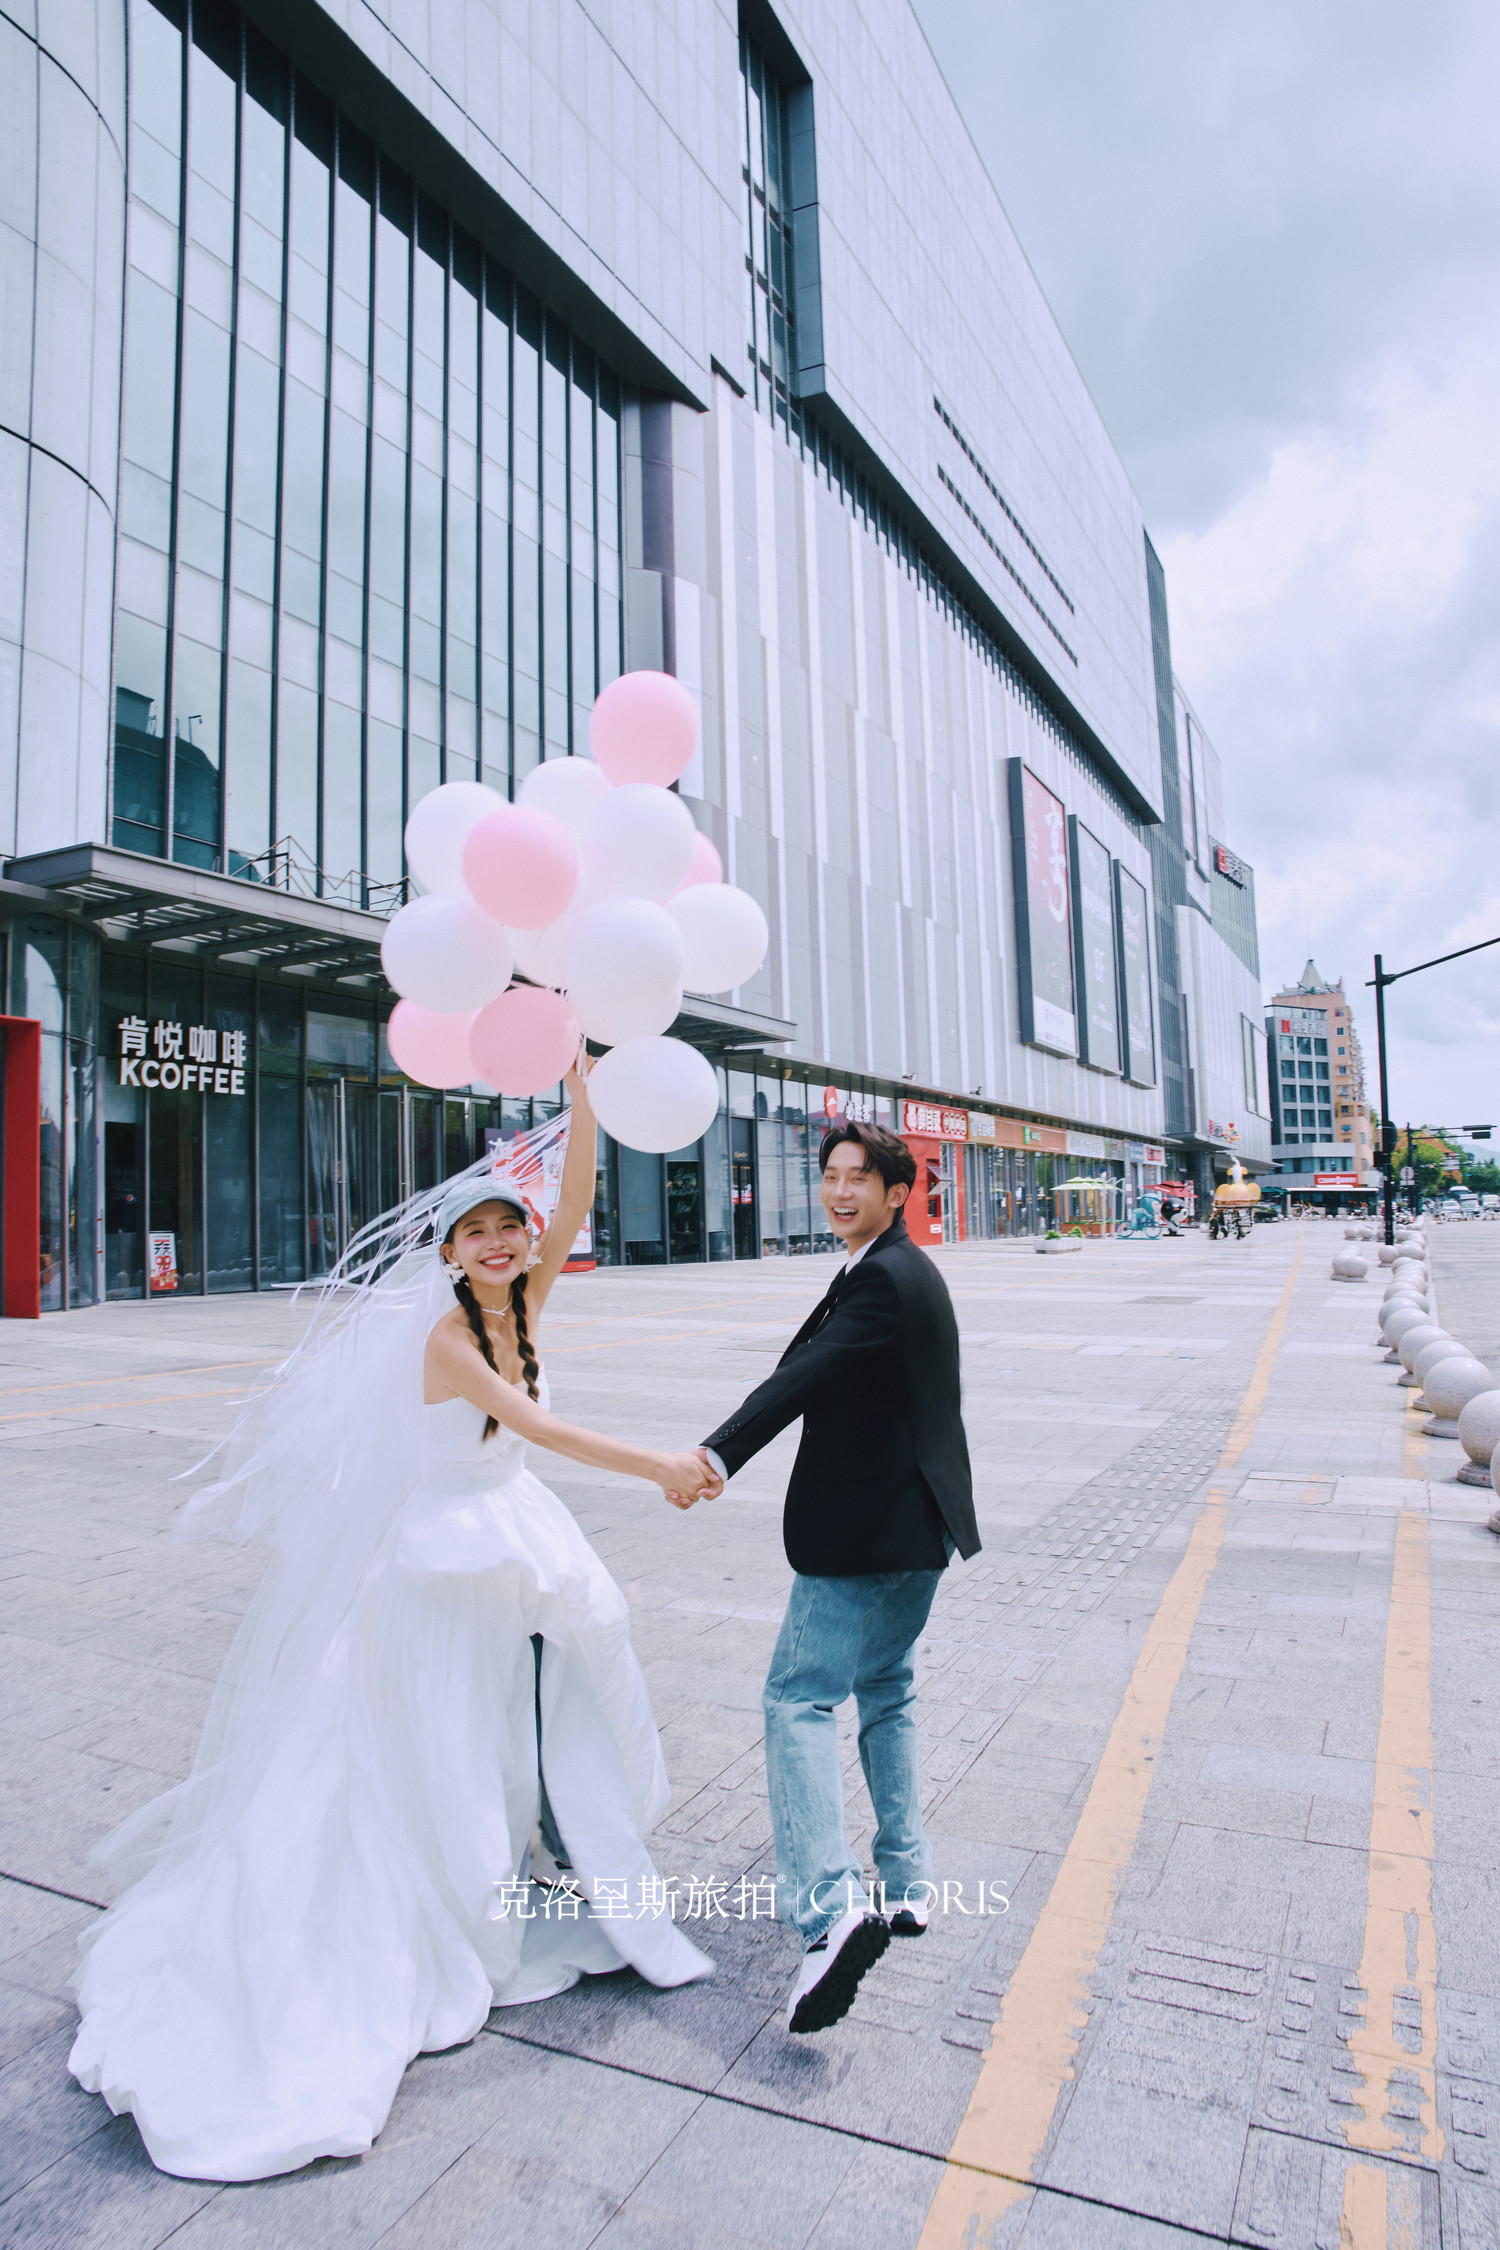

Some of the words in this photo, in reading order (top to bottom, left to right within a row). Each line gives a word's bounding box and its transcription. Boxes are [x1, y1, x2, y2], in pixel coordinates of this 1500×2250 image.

[118, 1015, 247, 1068] 肯悦咖啡
[119, 1057, 246, 1095] KCOFFEE
